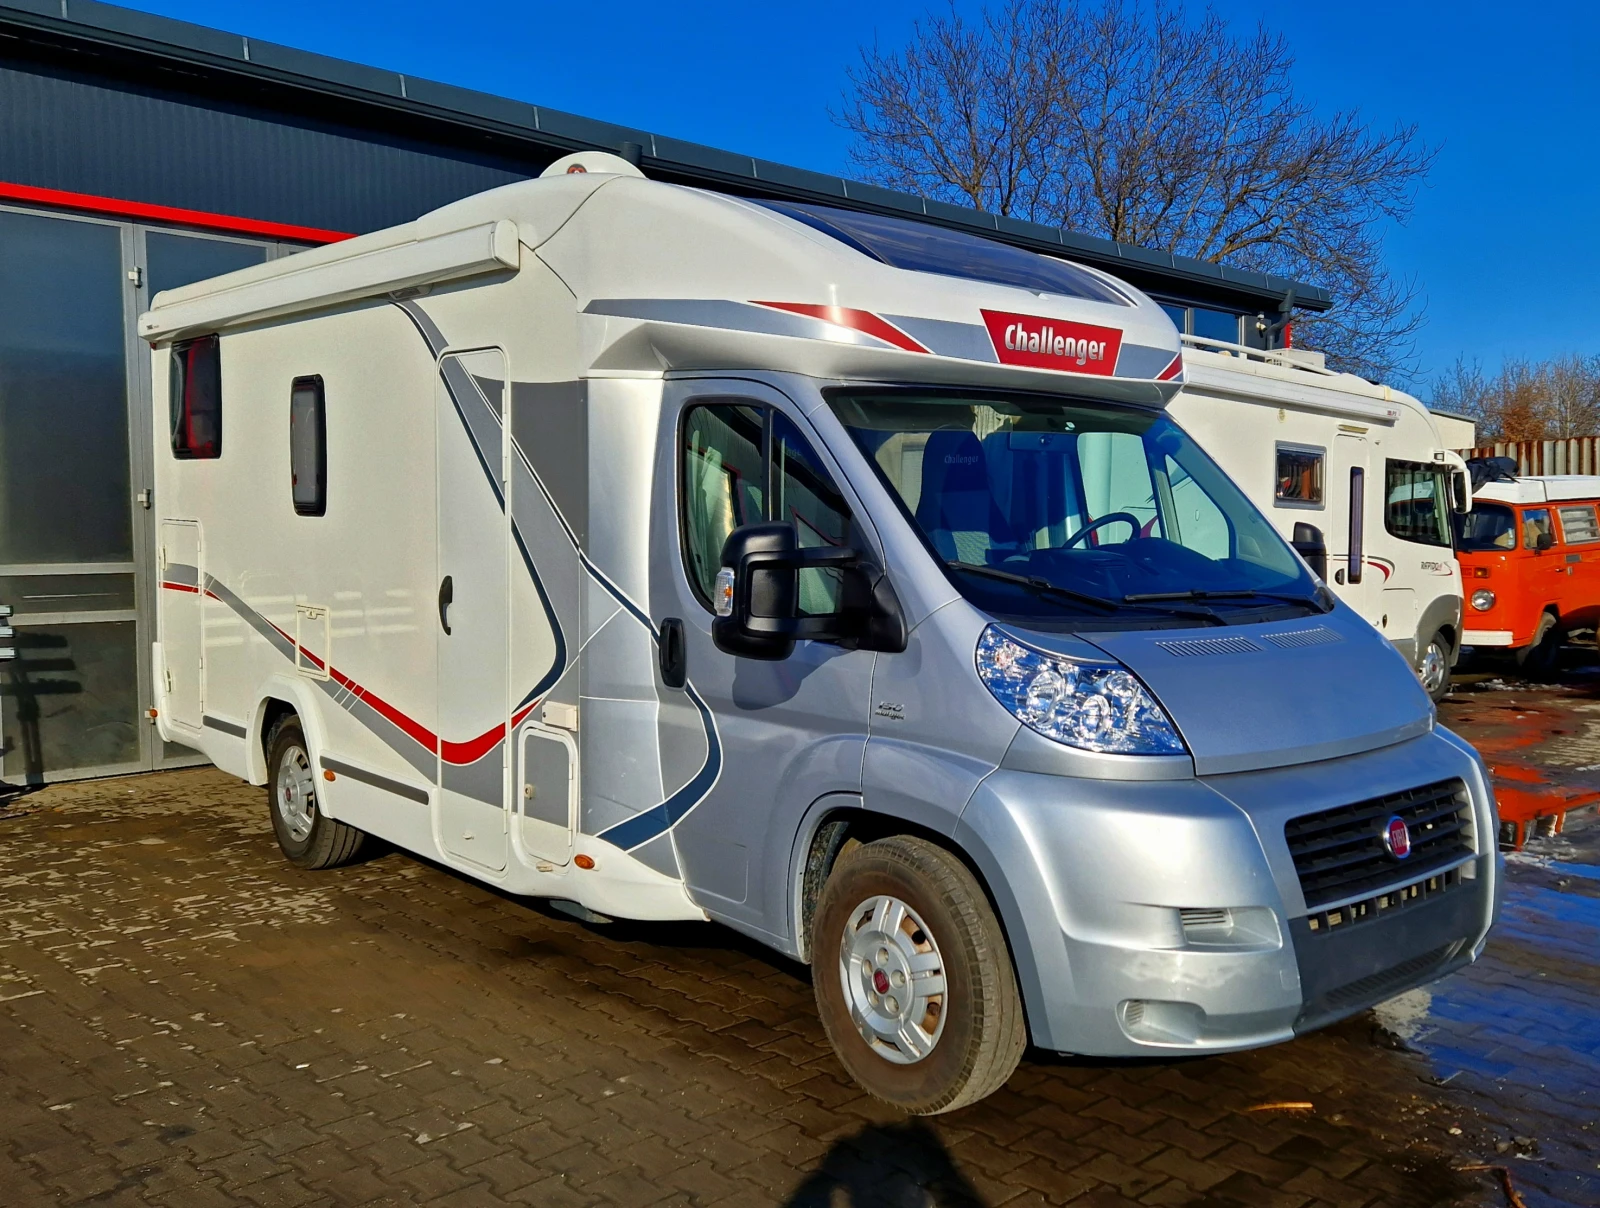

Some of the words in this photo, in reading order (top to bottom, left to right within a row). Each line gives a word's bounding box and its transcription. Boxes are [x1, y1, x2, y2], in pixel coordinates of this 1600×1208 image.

[1004, 322, 1106, 366] Challenger
[944, 454, 979, 466] Challenger
[1392, 827, 1407, 849] FIAT
